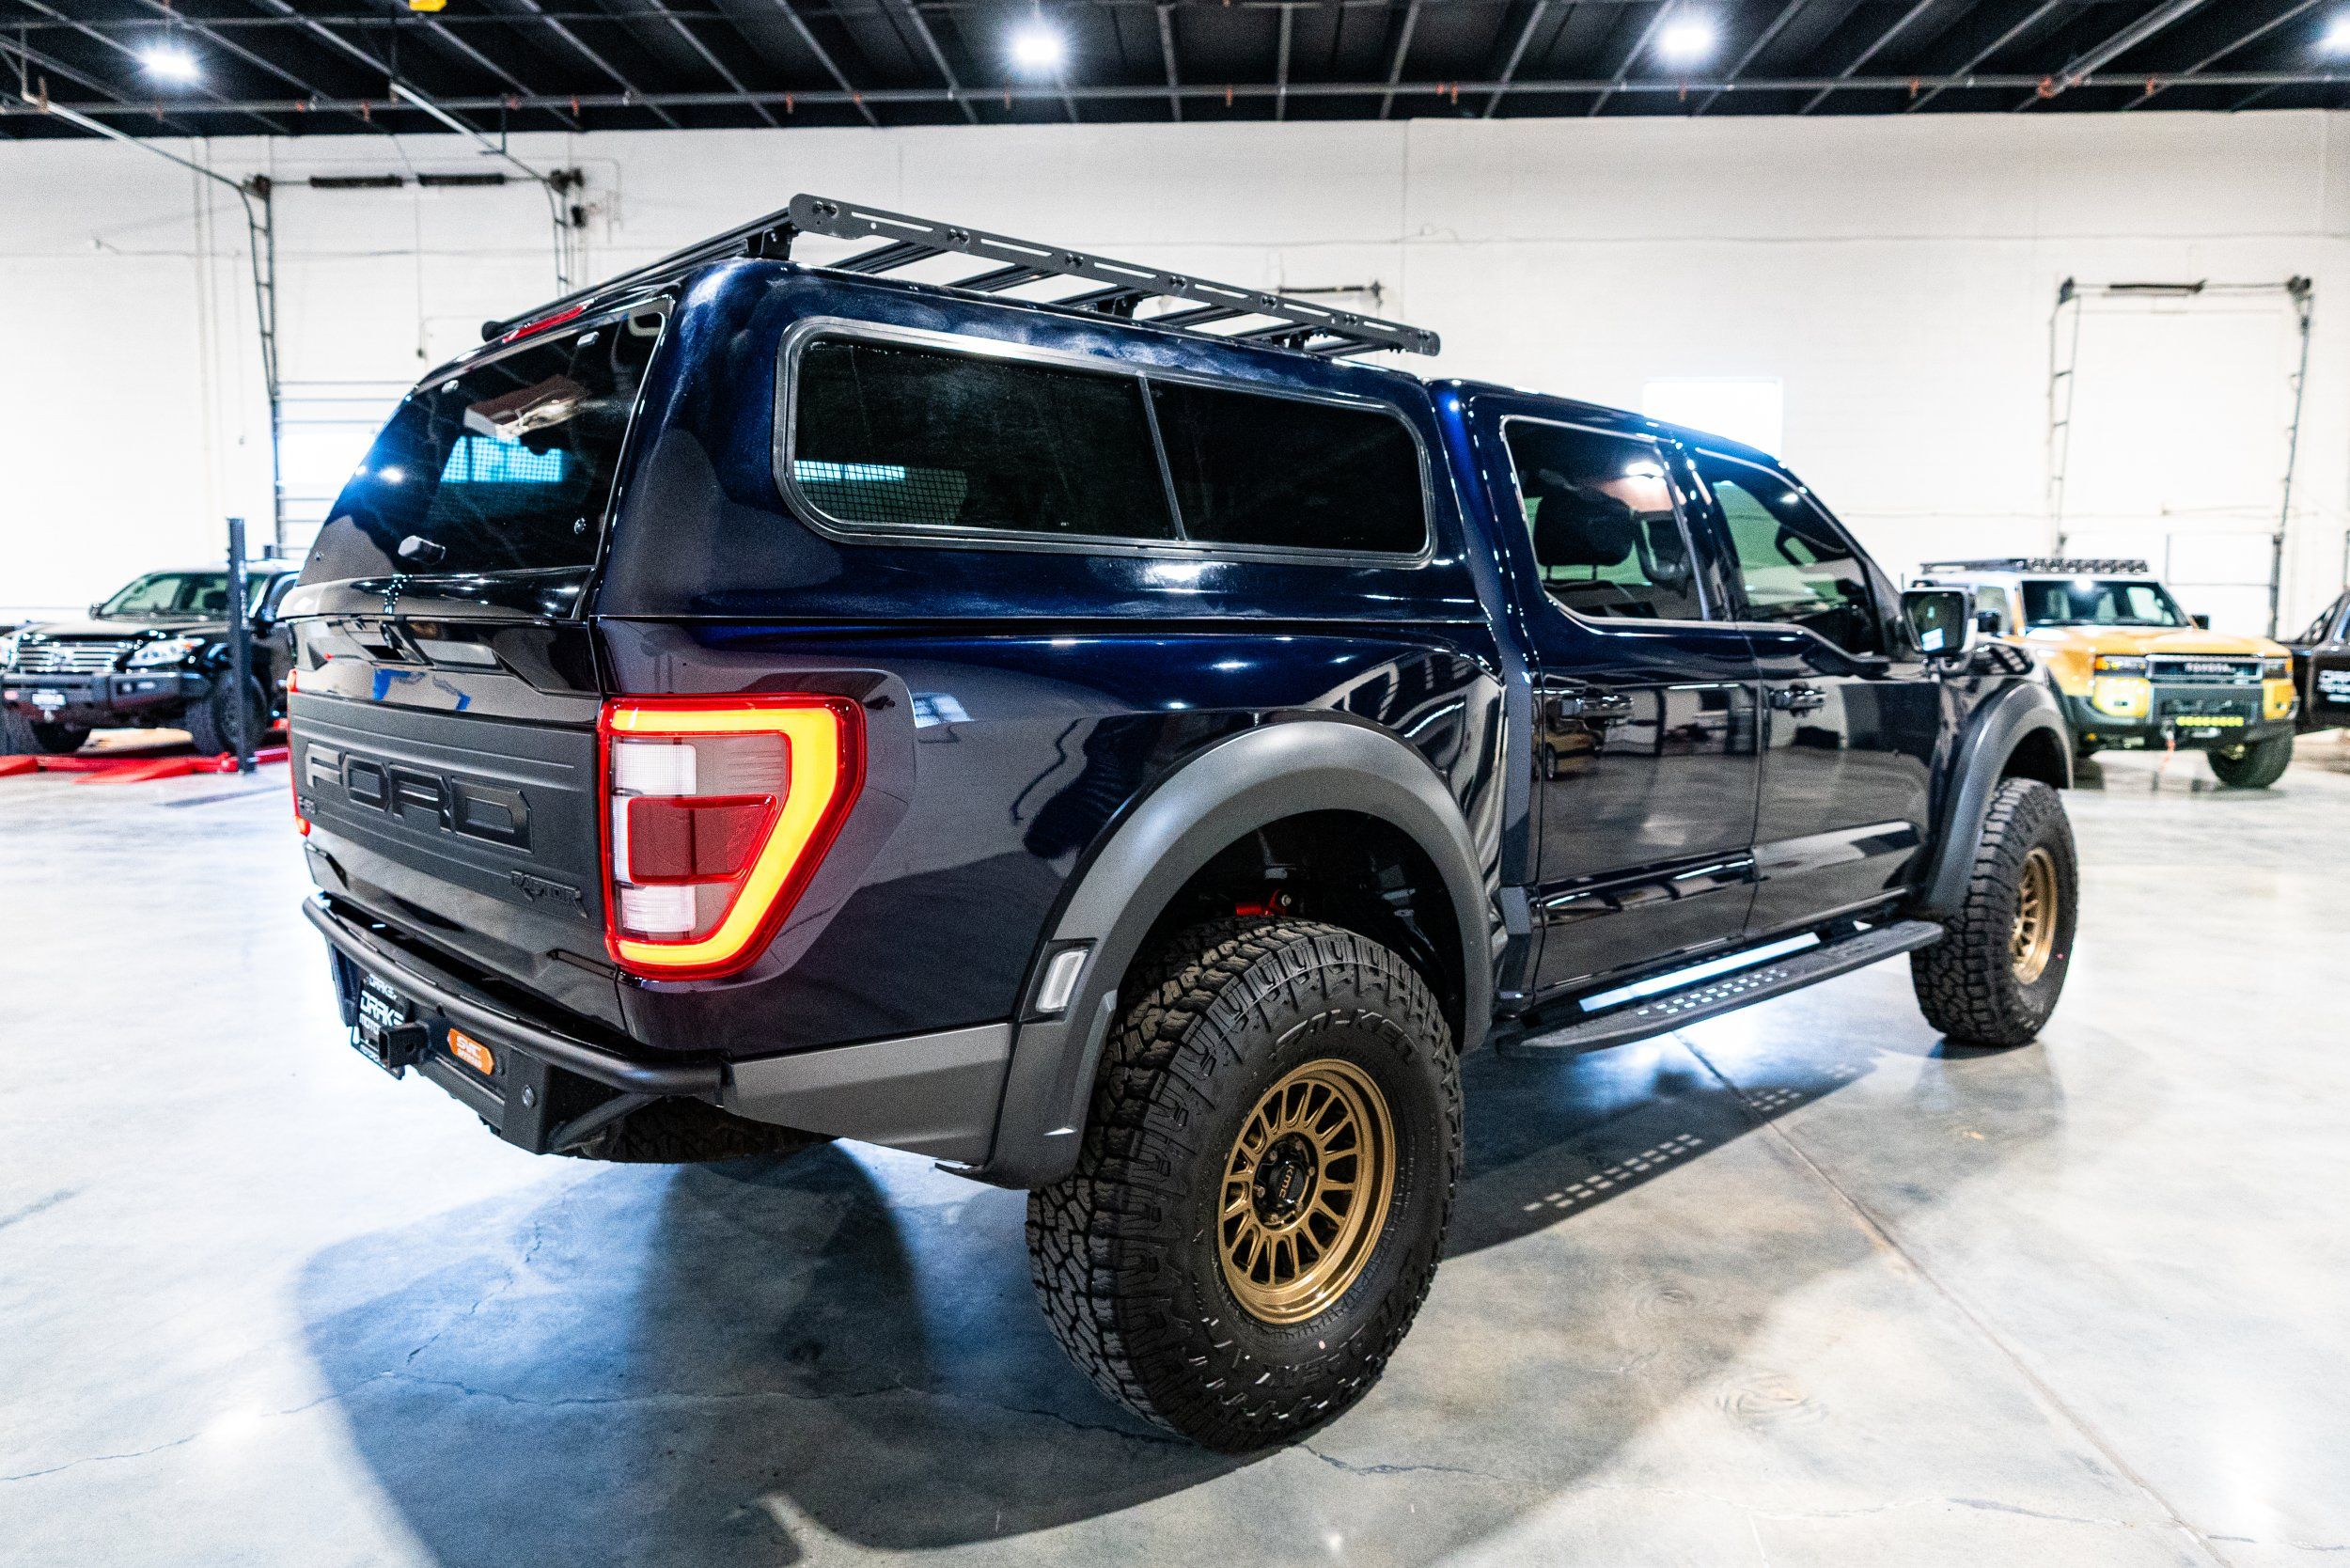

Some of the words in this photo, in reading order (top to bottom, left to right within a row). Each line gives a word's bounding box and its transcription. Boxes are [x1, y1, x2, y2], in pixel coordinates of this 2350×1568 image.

[306, 743, 533, 853] FORD
[510, 870, 588, 918] RAPTOR
[360, 990, 404, 1027] DRAKE
